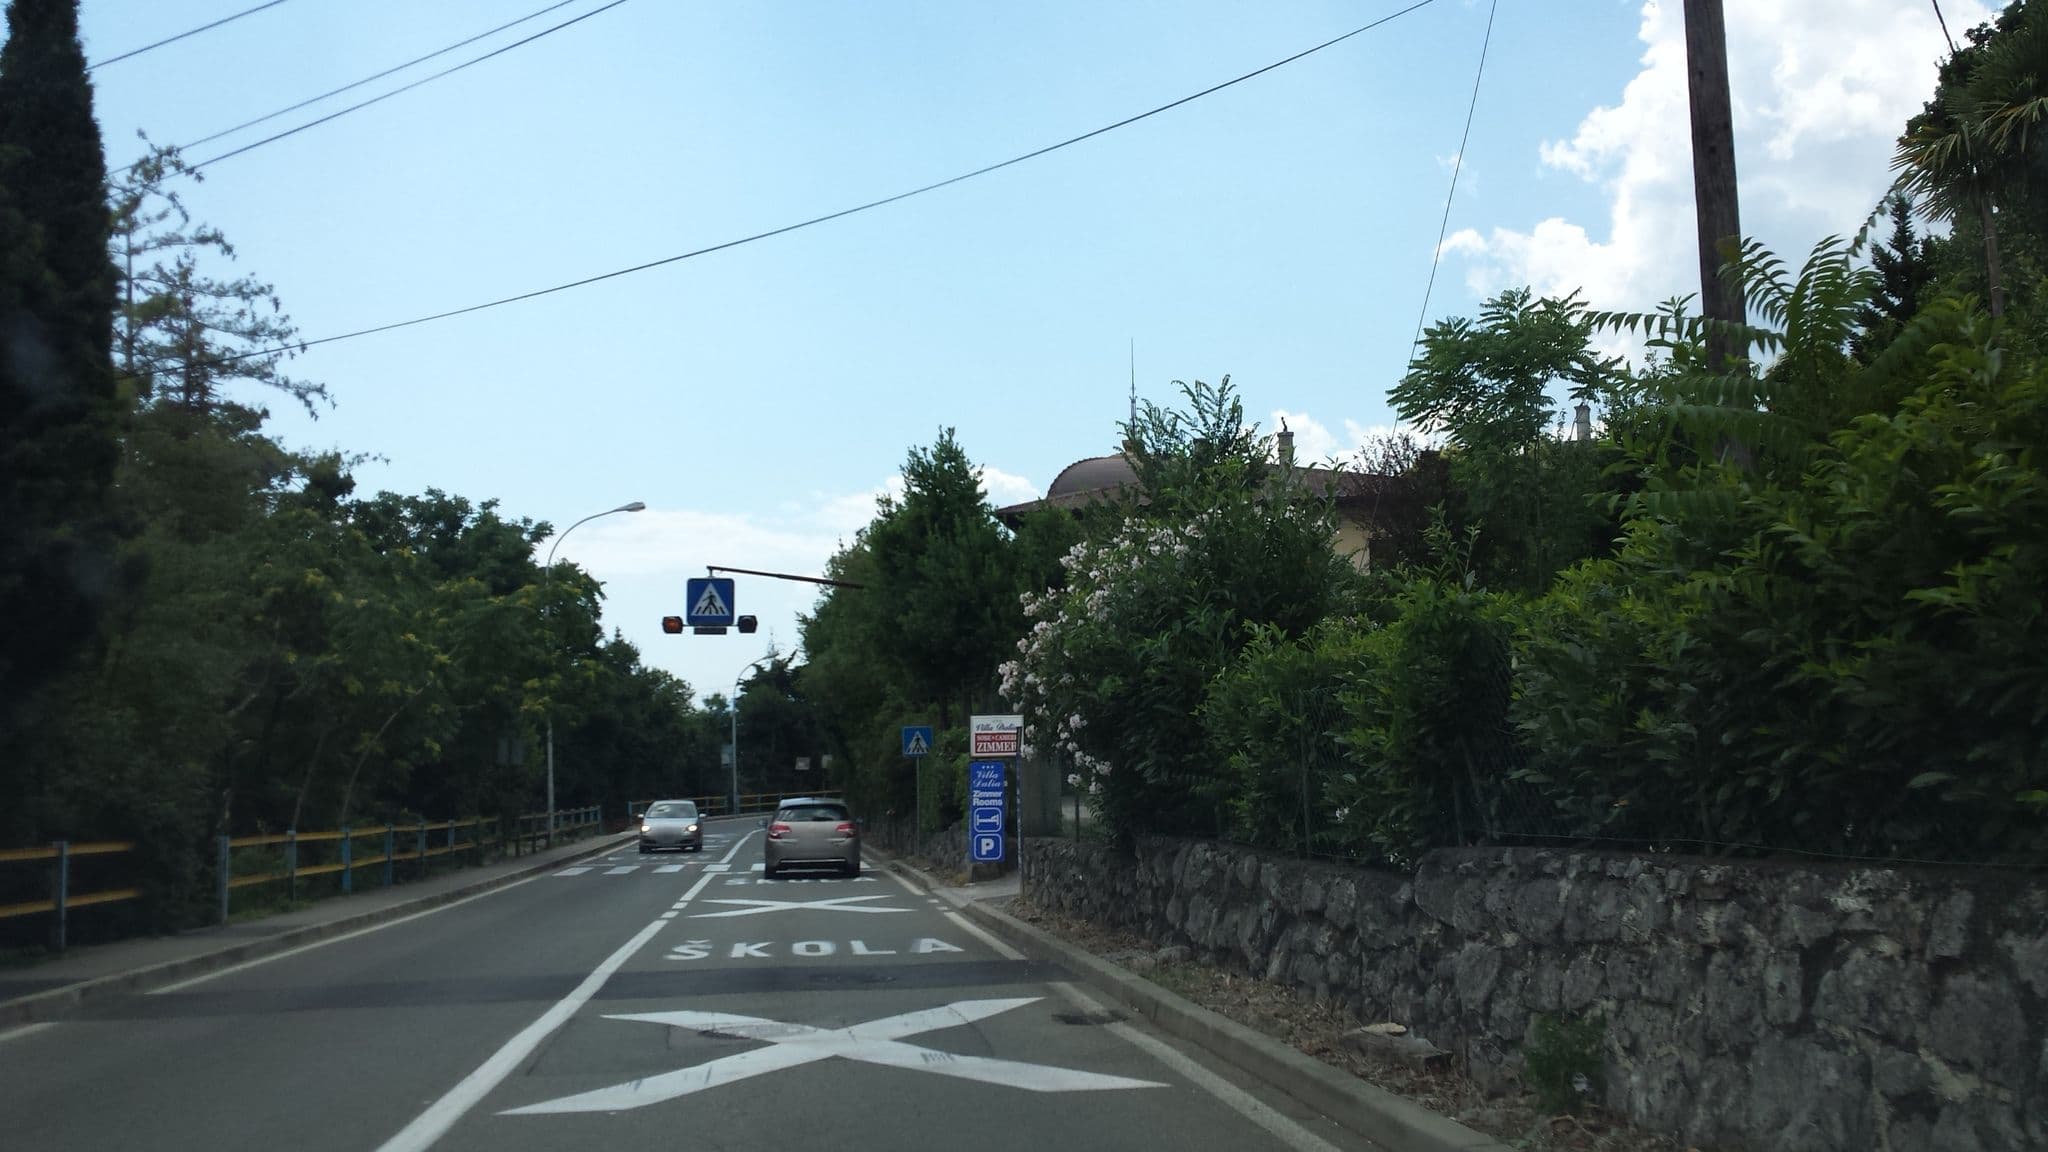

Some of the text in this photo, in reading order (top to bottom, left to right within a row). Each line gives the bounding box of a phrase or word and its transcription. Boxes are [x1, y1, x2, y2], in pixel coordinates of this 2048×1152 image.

[976, 742, 1017, 752] ZIMMER
[976, 770, 999, 779] Villa
[973, 790, 1002, 798] Zimmer
[973, 798, 1002, 806] Rooms
[981, 838, 995, 856] P
[663, 937, 965, 960] ŠKOLA
